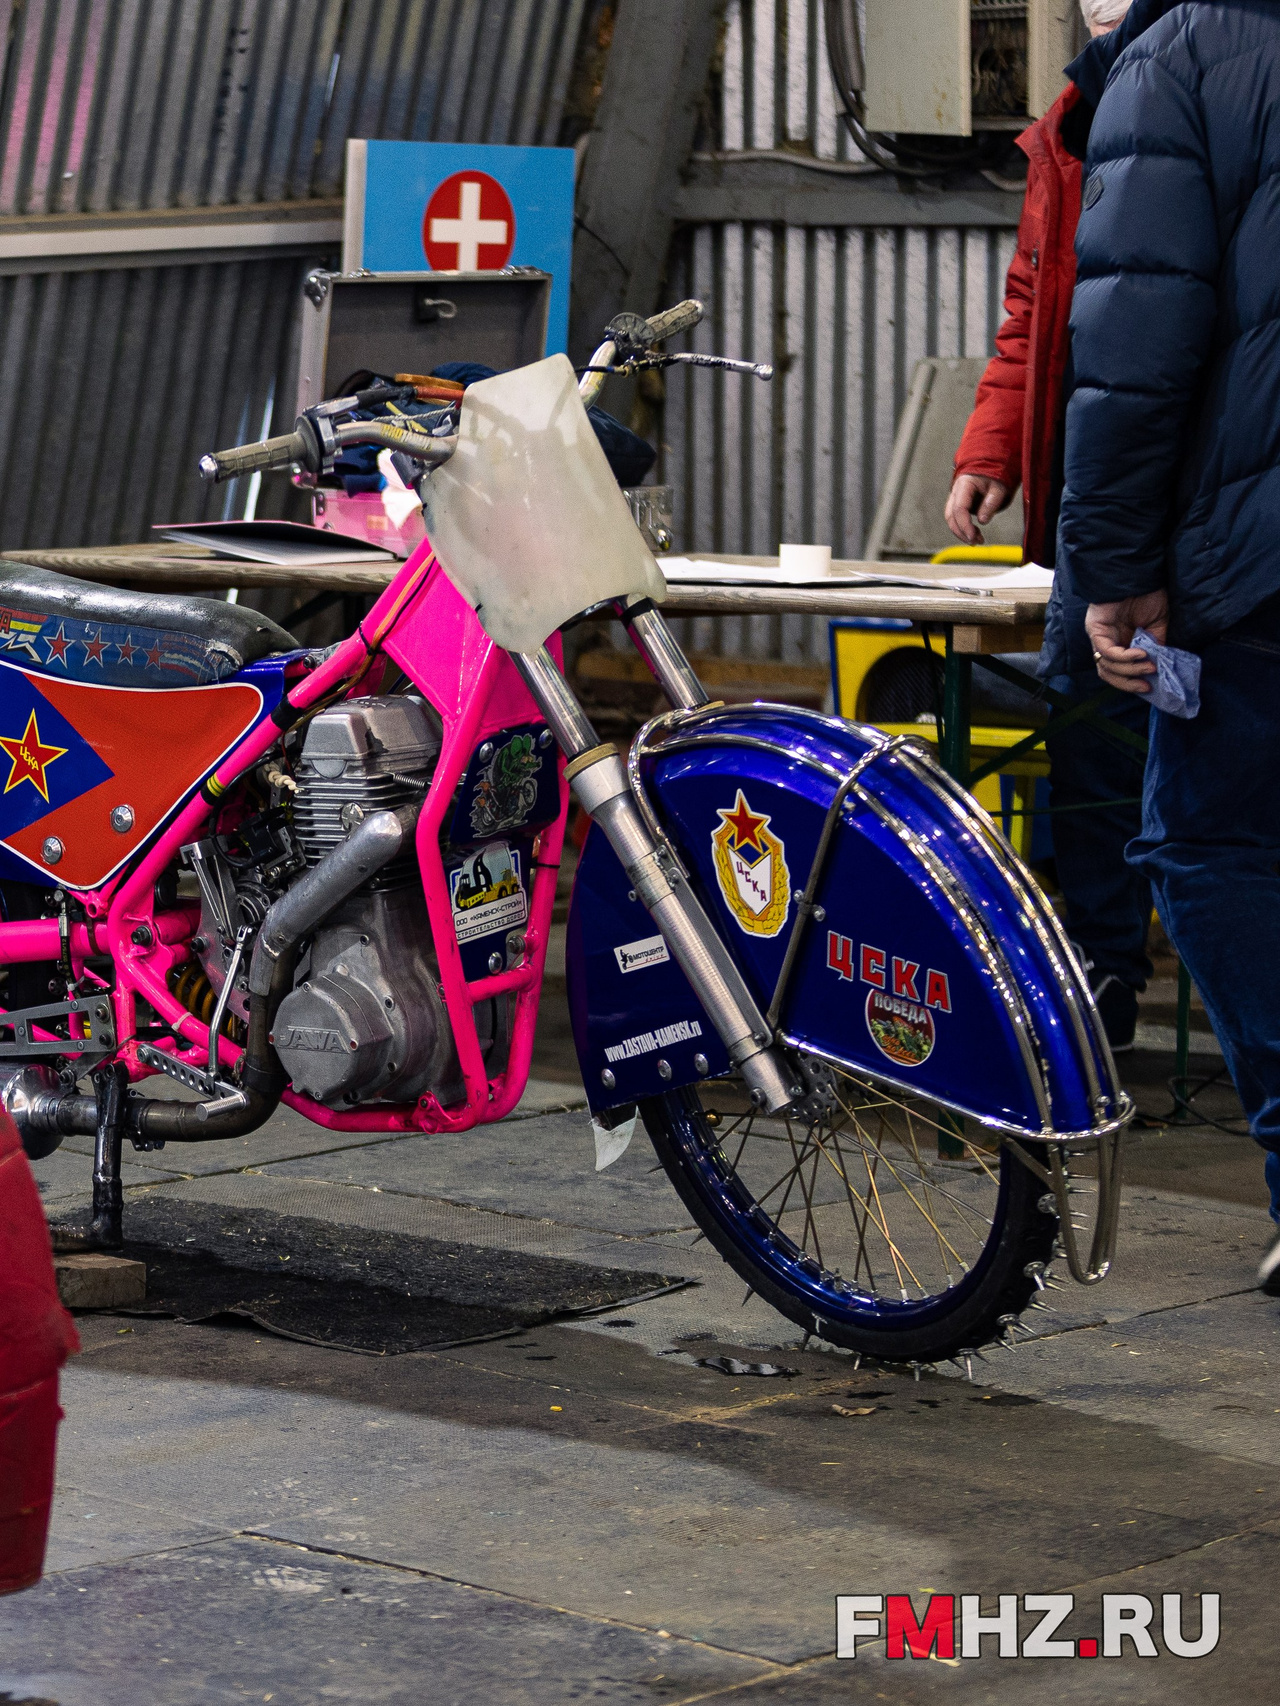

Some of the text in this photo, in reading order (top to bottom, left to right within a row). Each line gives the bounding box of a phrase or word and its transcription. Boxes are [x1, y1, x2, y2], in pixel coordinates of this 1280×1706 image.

[20, 745, 39, 771] ЦСКА
[735, 861, 767, 902] ЦСКА
[457, 918, 505, 939] СТРОИТЕЛЬСТВО
[826, 930, 952, 1013] ЦСКА
[874, 992, 927, 1024] ПОБЕДА
[278, 1027, 349, 1054] JAWA
